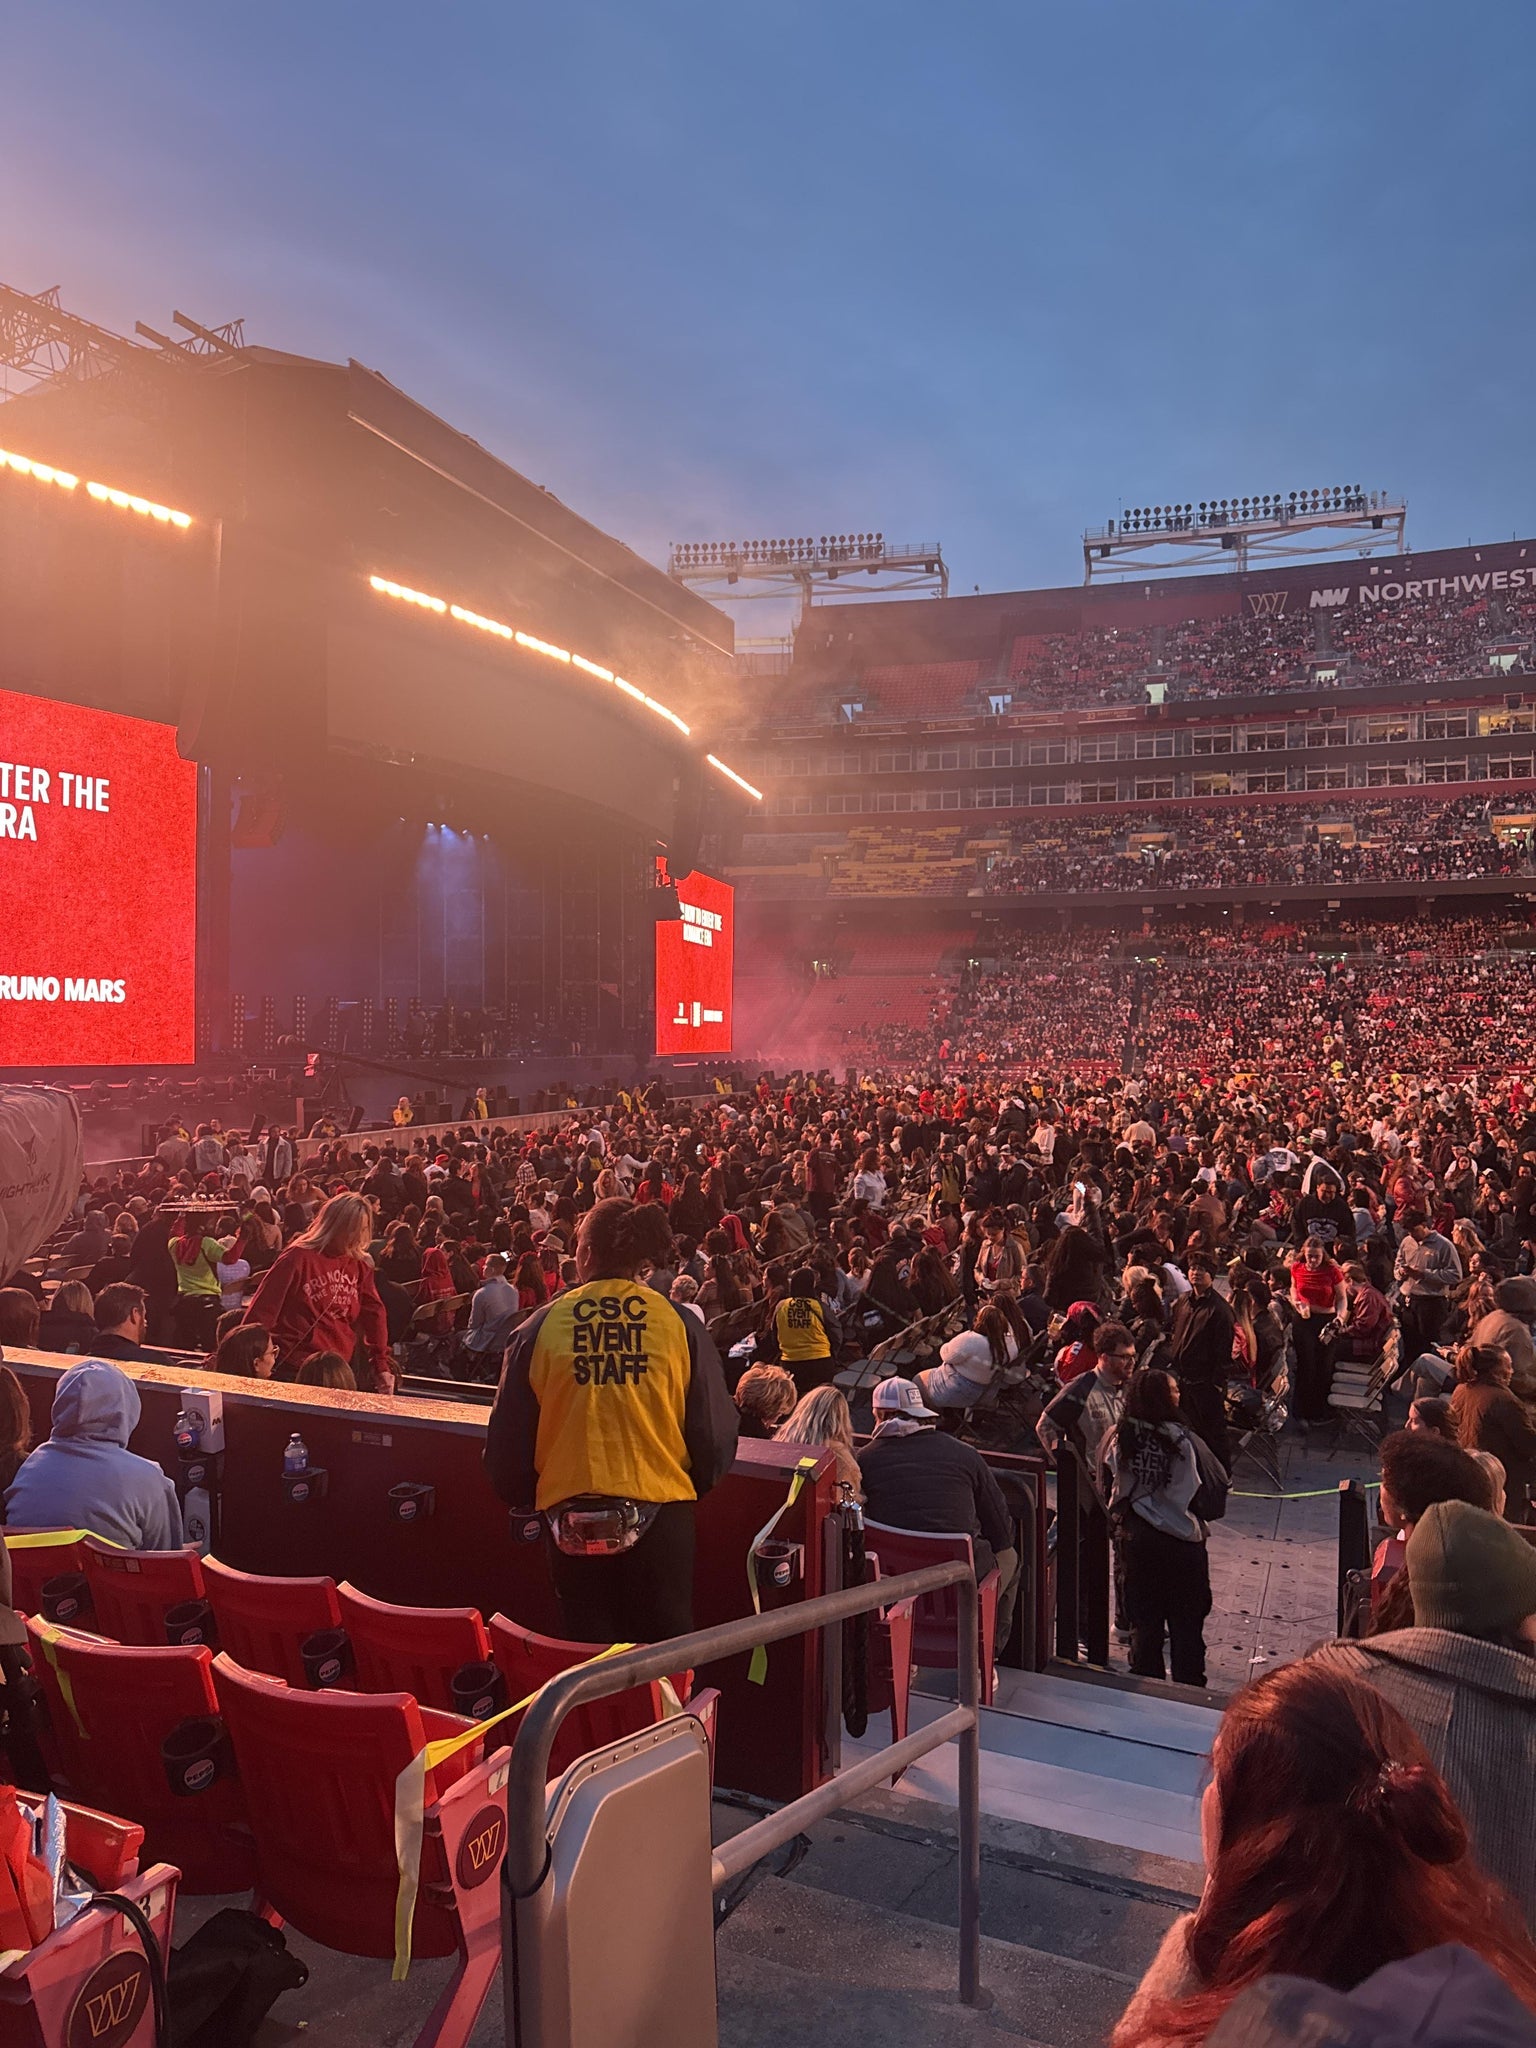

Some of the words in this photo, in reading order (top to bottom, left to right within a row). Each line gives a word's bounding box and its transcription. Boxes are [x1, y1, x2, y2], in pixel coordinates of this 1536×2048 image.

[1359, 567, 1536, 603] NORTHWEST
[0, 761, 50, 804] TER
[58, 772, 110, 813] THE
[64, 978, 126, 1003] MARS
[573, 1296, 648, 1323] CSC
[788, 1319, 812, 1328] STAFF
[573, 1322, 647, 1353] EVENT
[573, 1354, 648, 1385] STAFF
[186, 1763, 213, 1783] PEPSI
